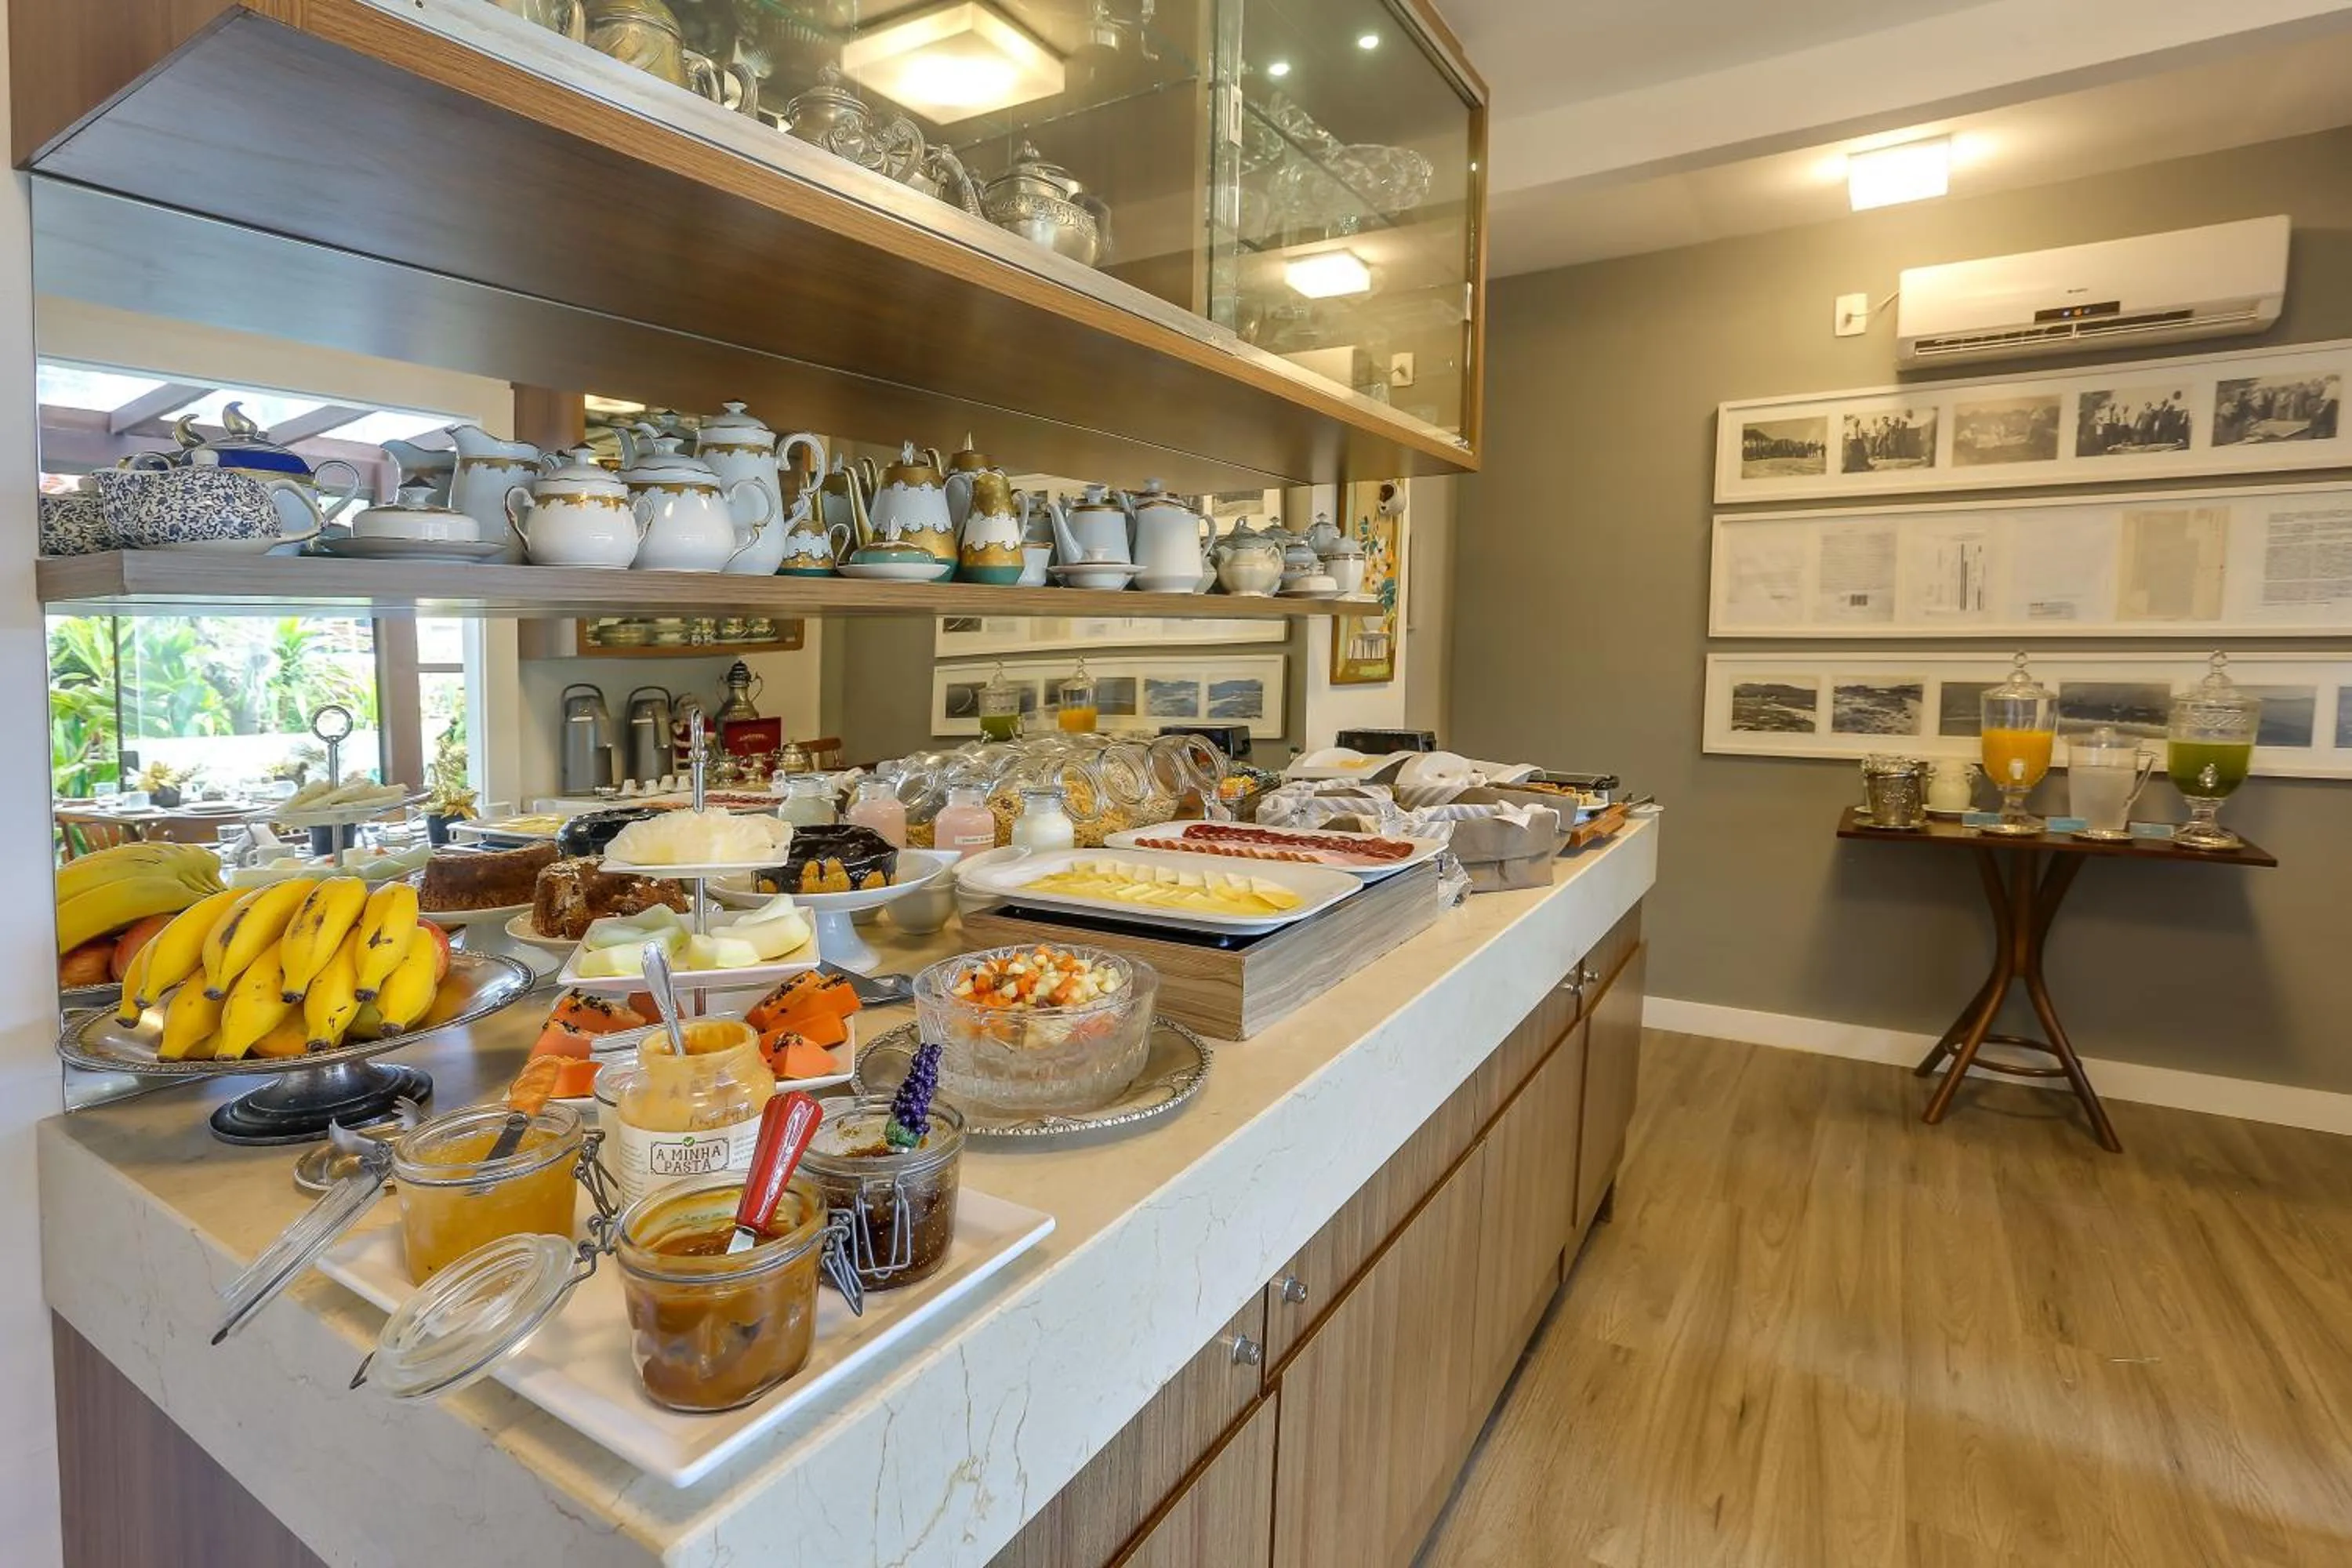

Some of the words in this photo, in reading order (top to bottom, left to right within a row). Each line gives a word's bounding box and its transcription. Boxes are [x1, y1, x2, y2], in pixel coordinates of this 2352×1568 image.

[656, 1149, 666, 1160] A
[672, 1145, 721, 1161] MINHA
[664, 1159, 711, 1173] PASTA
